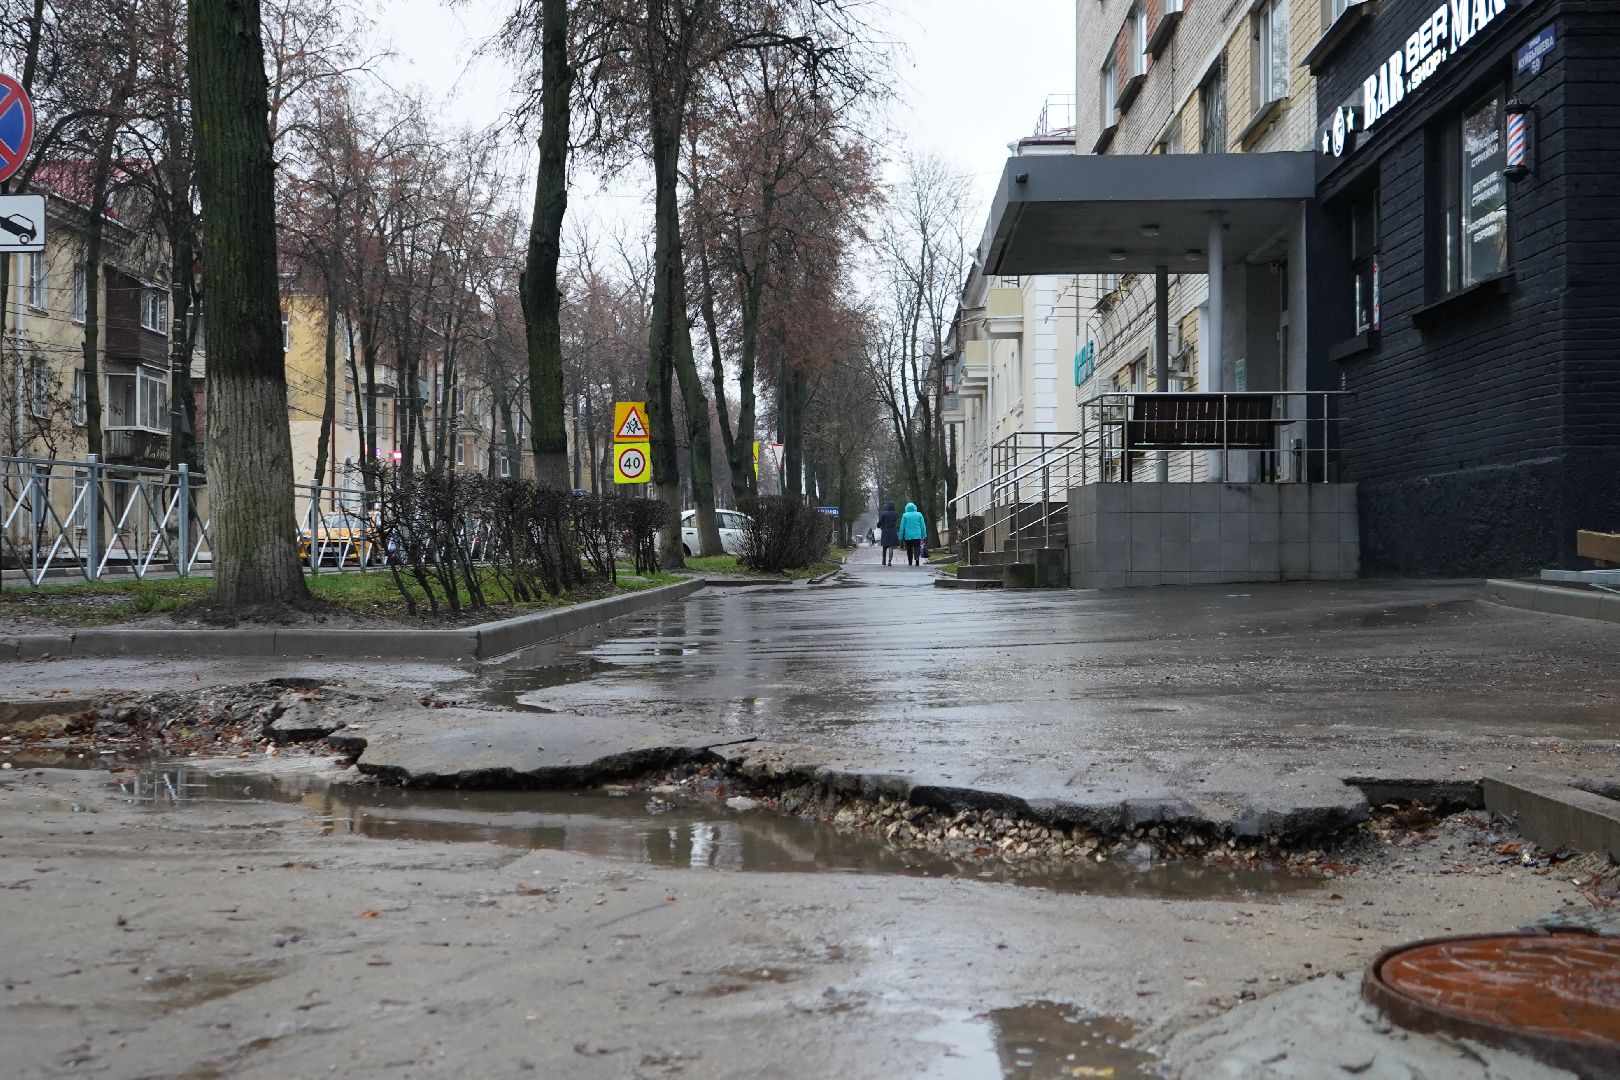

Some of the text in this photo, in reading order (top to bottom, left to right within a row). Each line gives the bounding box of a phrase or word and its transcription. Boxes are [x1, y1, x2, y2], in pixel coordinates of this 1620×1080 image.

[1364, 50, 1405, 130] BAR
[1405, 4, 1448, 73] BER
[1411, 48, 1442, 90] SHOP
[1518, 35, 1555, 70] КУЙБЫШЕВА
[623, 457, 640, 469] 40
